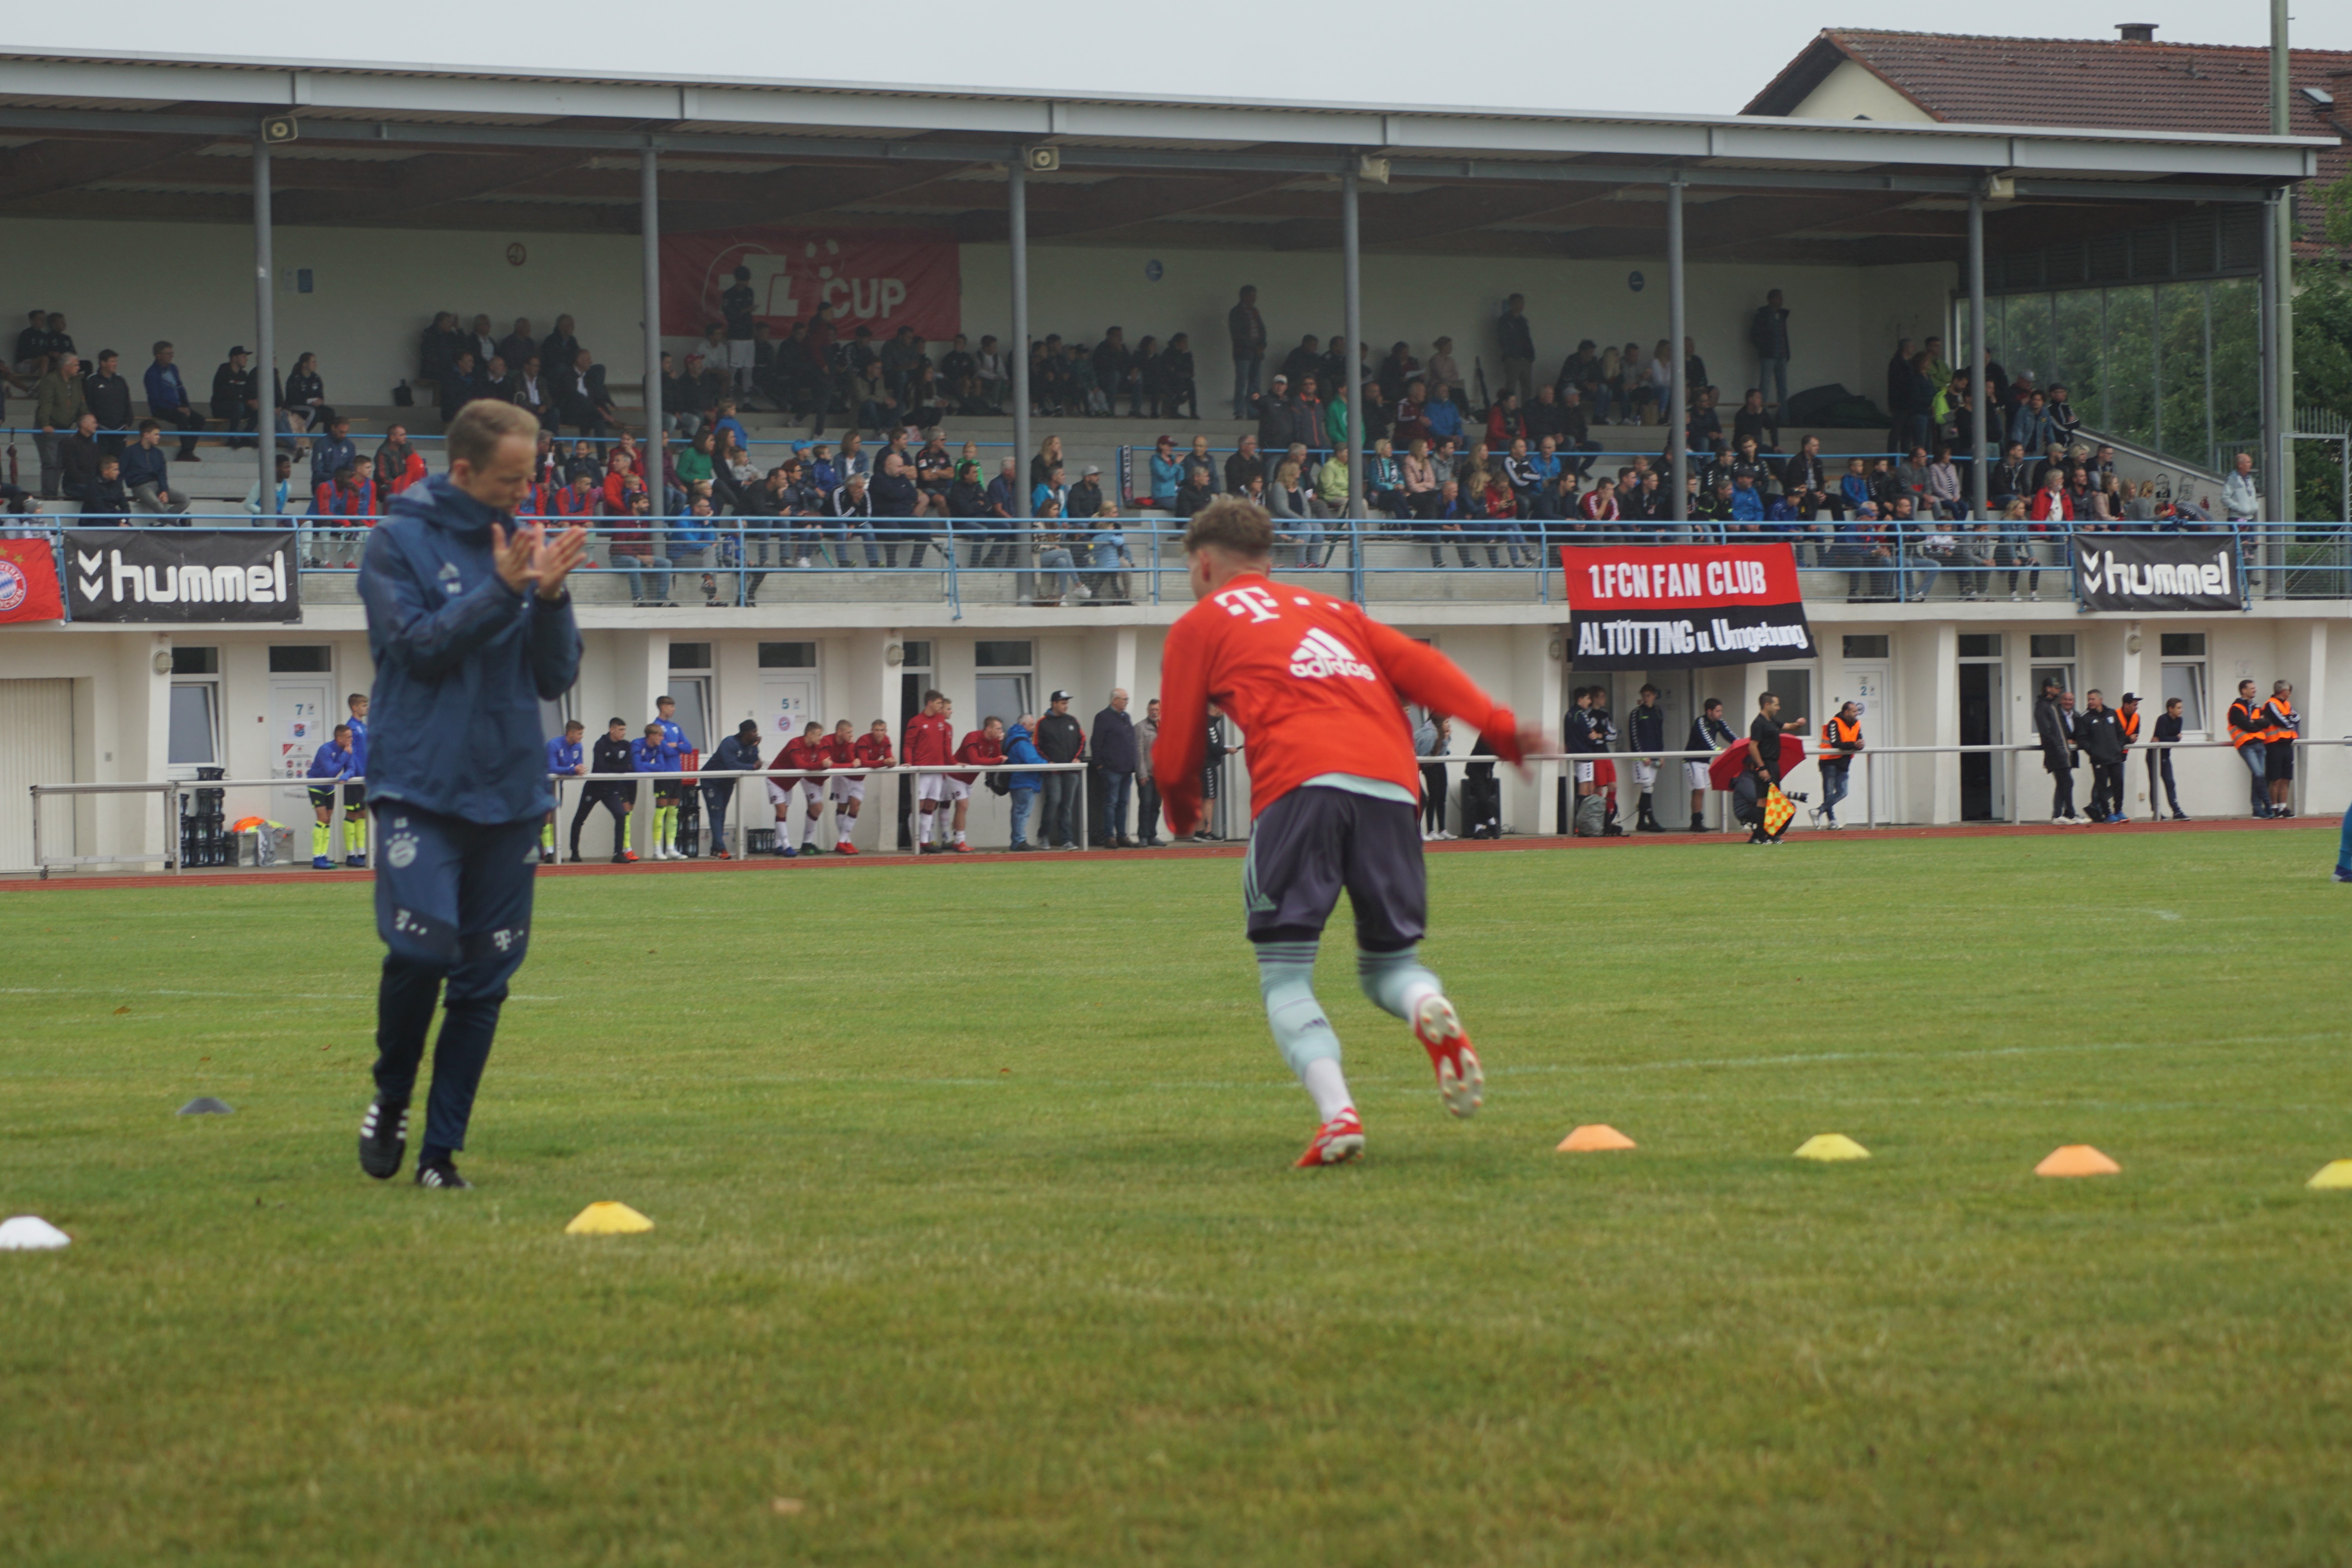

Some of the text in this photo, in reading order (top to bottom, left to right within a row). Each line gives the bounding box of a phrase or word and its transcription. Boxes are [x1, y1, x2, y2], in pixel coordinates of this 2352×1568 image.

[822, 277, 906, 319] CUP
[111, 549, 287, 602] hummel
[1652, 563, 1702, 598] FAN
[1706, 561, 1766, 595] CLUB
[2105, 550, 2230, 595] hummel
[1711, 619, 1808, 652] Umgebung
[1290, 657, 1376, 681] adidas
[782, 698, 789, 709] 5
[1860, 686, 1867, 696] 2
[296, 704, 303, 715] 7
